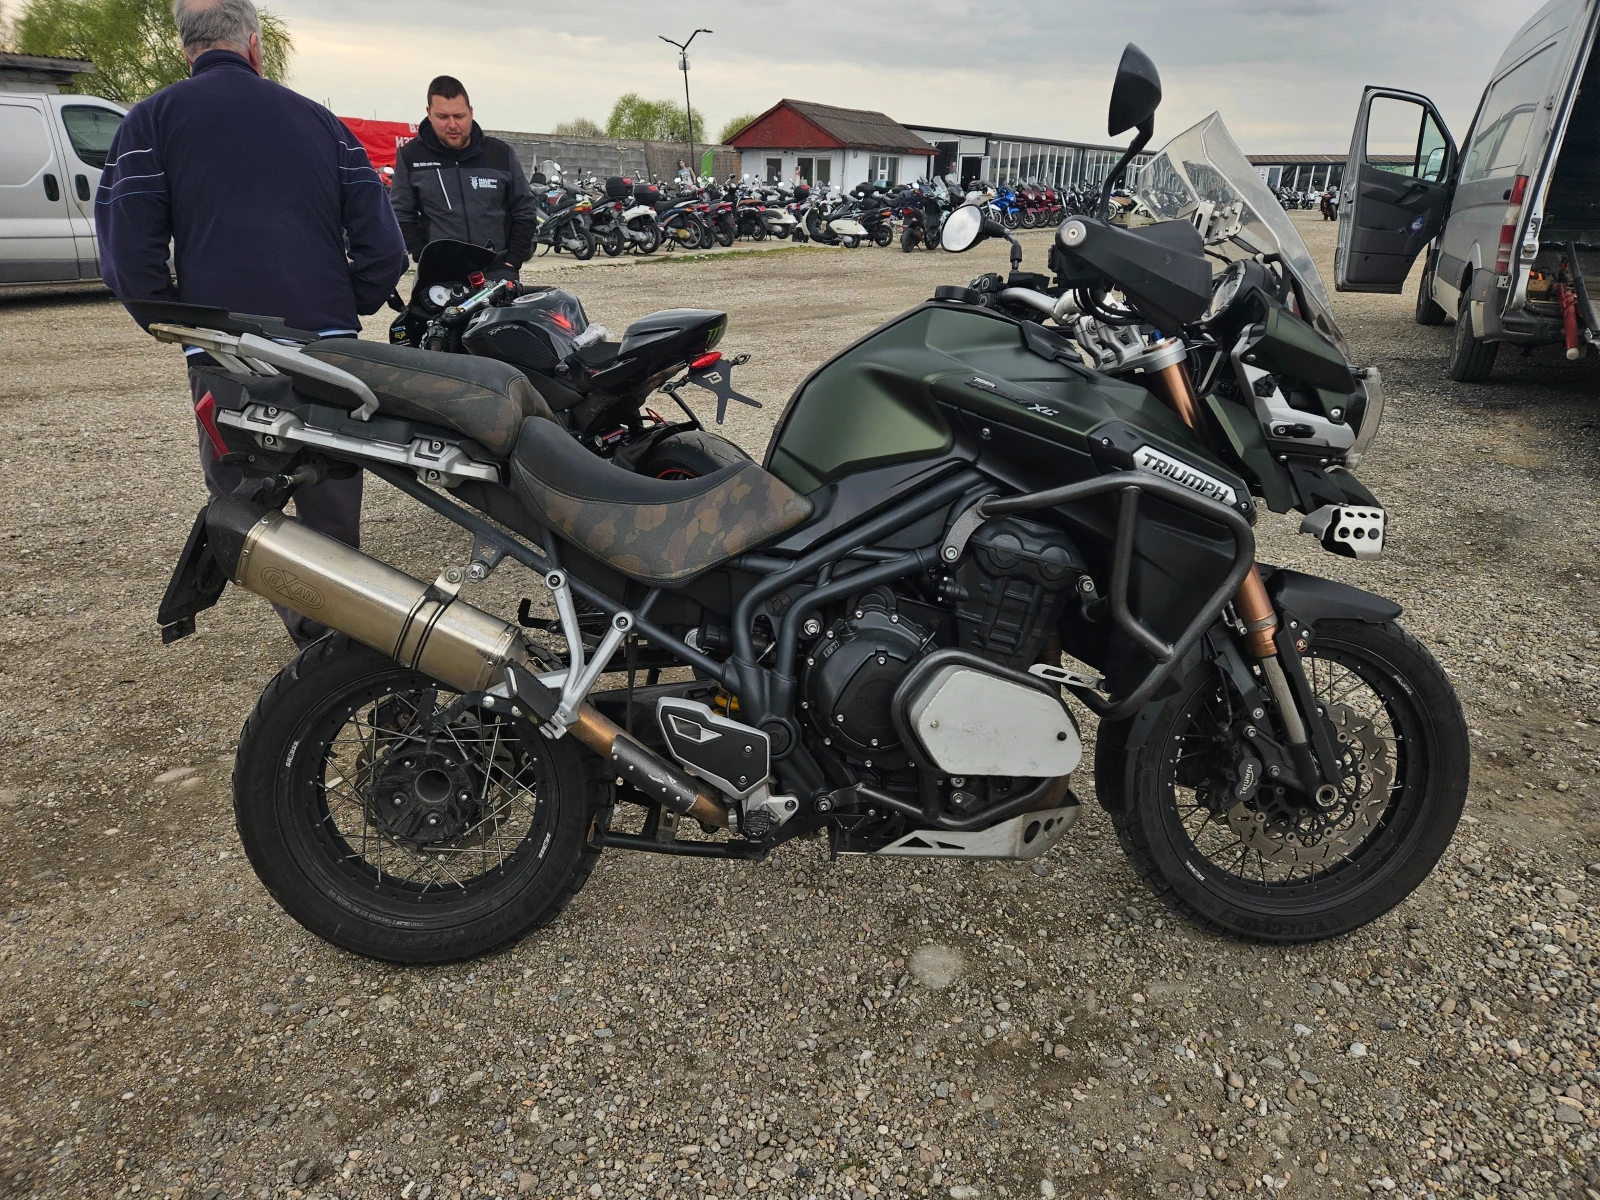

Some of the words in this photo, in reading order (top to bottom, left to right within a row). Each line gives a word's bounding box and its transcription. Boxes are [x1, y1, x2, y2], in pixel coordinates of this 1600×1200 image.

[1027, 403, 1059, 417] XC
[1142, 452, 1229, 502] TRIUMPH
[1239, 763, 1254, 795] TRIUMPH
